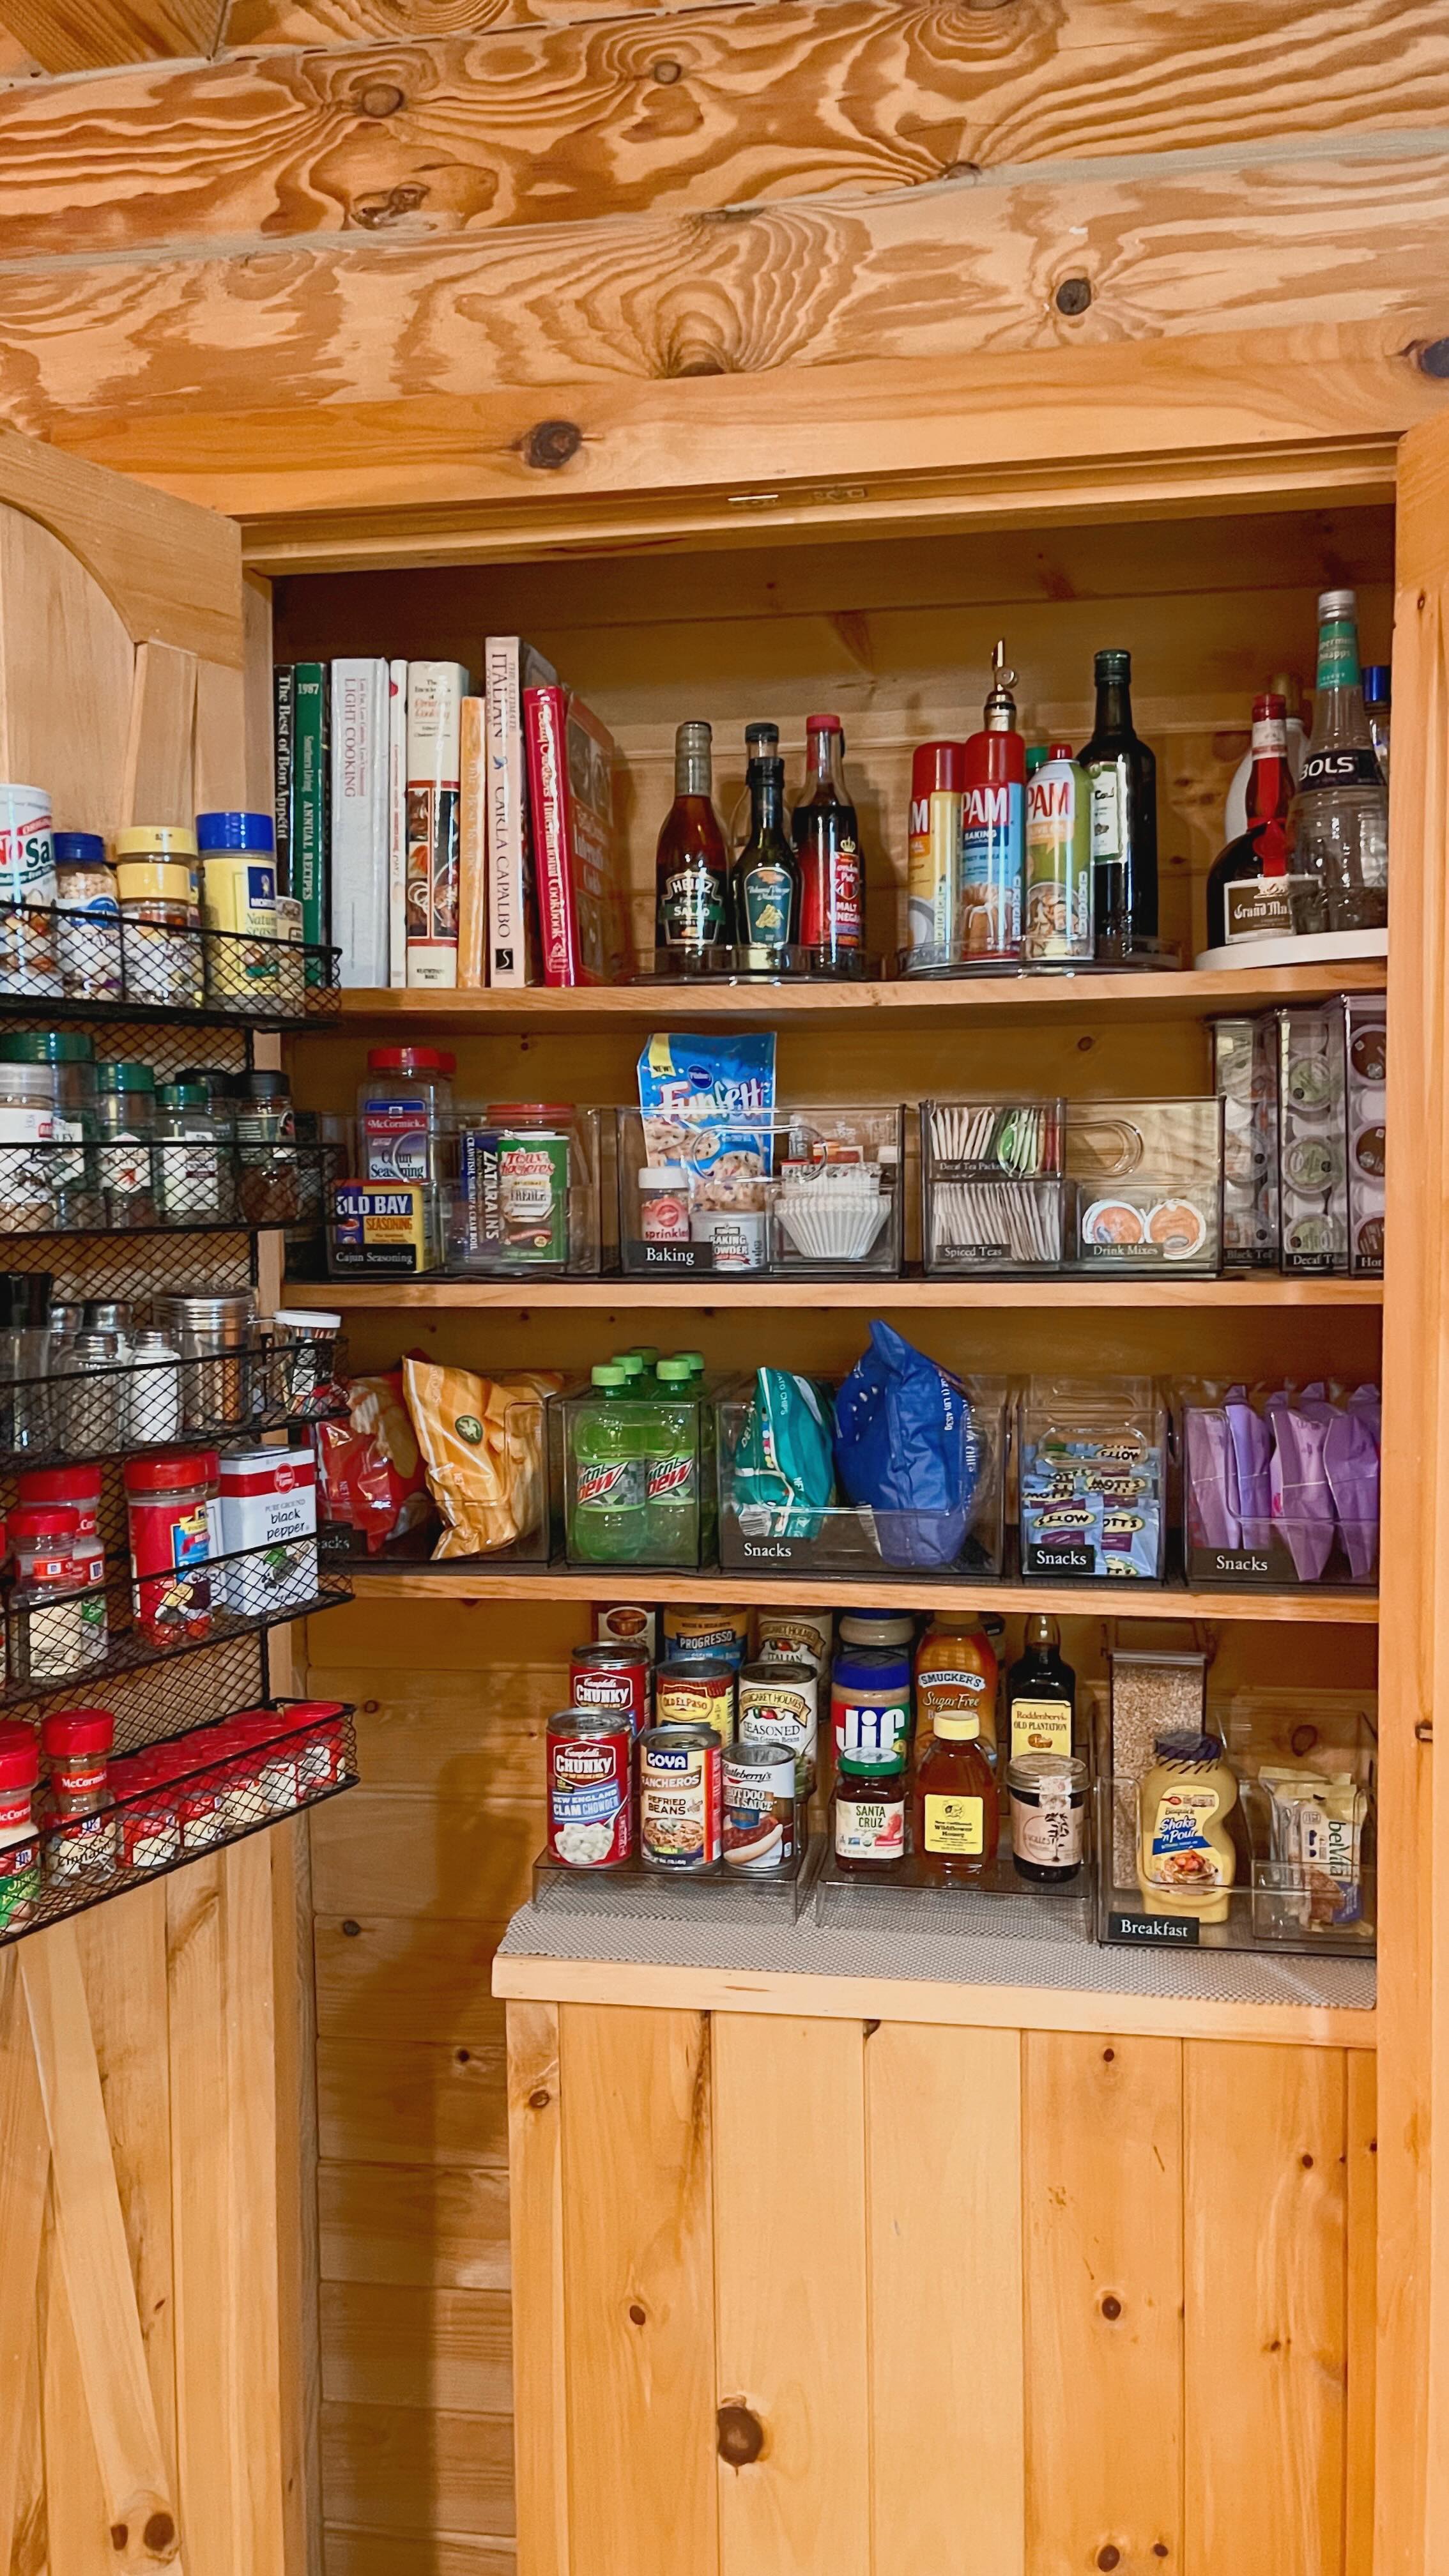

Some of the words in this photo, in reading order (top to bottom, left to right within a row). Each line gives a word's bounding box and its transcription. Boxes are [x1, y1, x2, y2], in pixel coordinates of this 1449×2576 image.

[279, 676, 291, 702] The
[492, 654, 507, 737] ITALIAN
[345, 678, 356, 722] LIGHT
[279, 705, 291, 735] Best
[278, 739, 289, 754] of
[345, 726, 356, 798] COOKING
[1299, 756, 1354, 781] BOLS
[277, 756, 290, 785] Bon
[963, 787, 1008, 824] PAM
[1027, 781, 1070, 818] PAM
[303, 801, 314, 849] ANNUAL
[965, 830, 997, 841] BAKING
[302, 852, 314, 900] RECIPES
[496, 856, 511, 939] CAPALBO
[836, 902, 857, 912] MALT
[1234, 903, 1267, 919] Grand
[827, 910, 861, 923] VNEGA
[368, 1120, 425, 1128] McCormick
[381, 1152, 412, 1165] Cun
[484, 1151, 499, 1239] ZATARAIN'S
[337, 1196, 369, 1215] OLD
[374, 1196, 408, 1215] BAY
[366, 1217, 413, 1231] SEASONING
[470, 1233, 478, 1250] BOIL
[710, 1235, 746, 1245] BAKING
[646, 1247, 694, 1266] Baking
[714, 1246, 748, 1255] OWDER
[945, 1246, 977, 1258] Spiced
[979, 1246, 1002, 1256] Teas
[1094, 1245, 1124, 1255] Drink
[1127, 1245, 1158, 1255] Mixes
[335, 1252, 364, 1264] Cajun
[366, 1252, 413, 1265] Seasoning
[1293, 1254, 1320, 1265] Decaf
[281, 1499, 305, 1509] GROUND
[271, 1508, 300, 1524] black
[267, 1522, 305, 1541] pepper
[318, 1536, 349, 1549] acks
[744, 1542, 792, 1558] Snacks
[1037, 1550, 1086, 1565] Snacks
[1216, 1556, 1268, 1572] Snacks
[680, 1630, 733, 1650] PROGRESSO
[768, 1653, 803, 1661] ITALIAN
[921, 1673, 981, 1687] SMUCKER'S
[576, 1684, 629, 1704] CHUNKY
[742, 1694, 772, 1706] RGARET
[773, 1693, 803, 1709] HOLMES
[923, 1691, 956, 1711] Sugar
[957, 1693, 979, 1710] Free
[743, 1721, 801, 1736] SEASONED
[836, 1709, 905, 1751] Jif
[1029, 1722, 1067, 1731] PLANTATION
[556, 1755, 613, 1774] CHUNKY
[647, 1752, 687, 1768] GOYA
[722, 1761, 772, 1782] Castleberry's
[572, 1789, 617, 1803] ENGLAND
[648, 1795, 686, 1806] REFRIED
[743, 1790, 765, 1801] DOG
[554, 1804, 582, 1816] CLAM
[582, 1797, 619, 1815] CHOWDER
[648, 1803, 686, 1815] BEANS
[741, 1798, 773, 1811] SAUCE
[856, 1805, 886, 1818] SANTA
[859, 1817, 884, 1828] CRUZ
[1160, 1815, 1196, 1833] Shake
[1169, 1828, 1197, 1843] Pour
[1329, 1821, 1353, 1876] belVita
[1121, 1920, 1188, 1937] Breakfast
